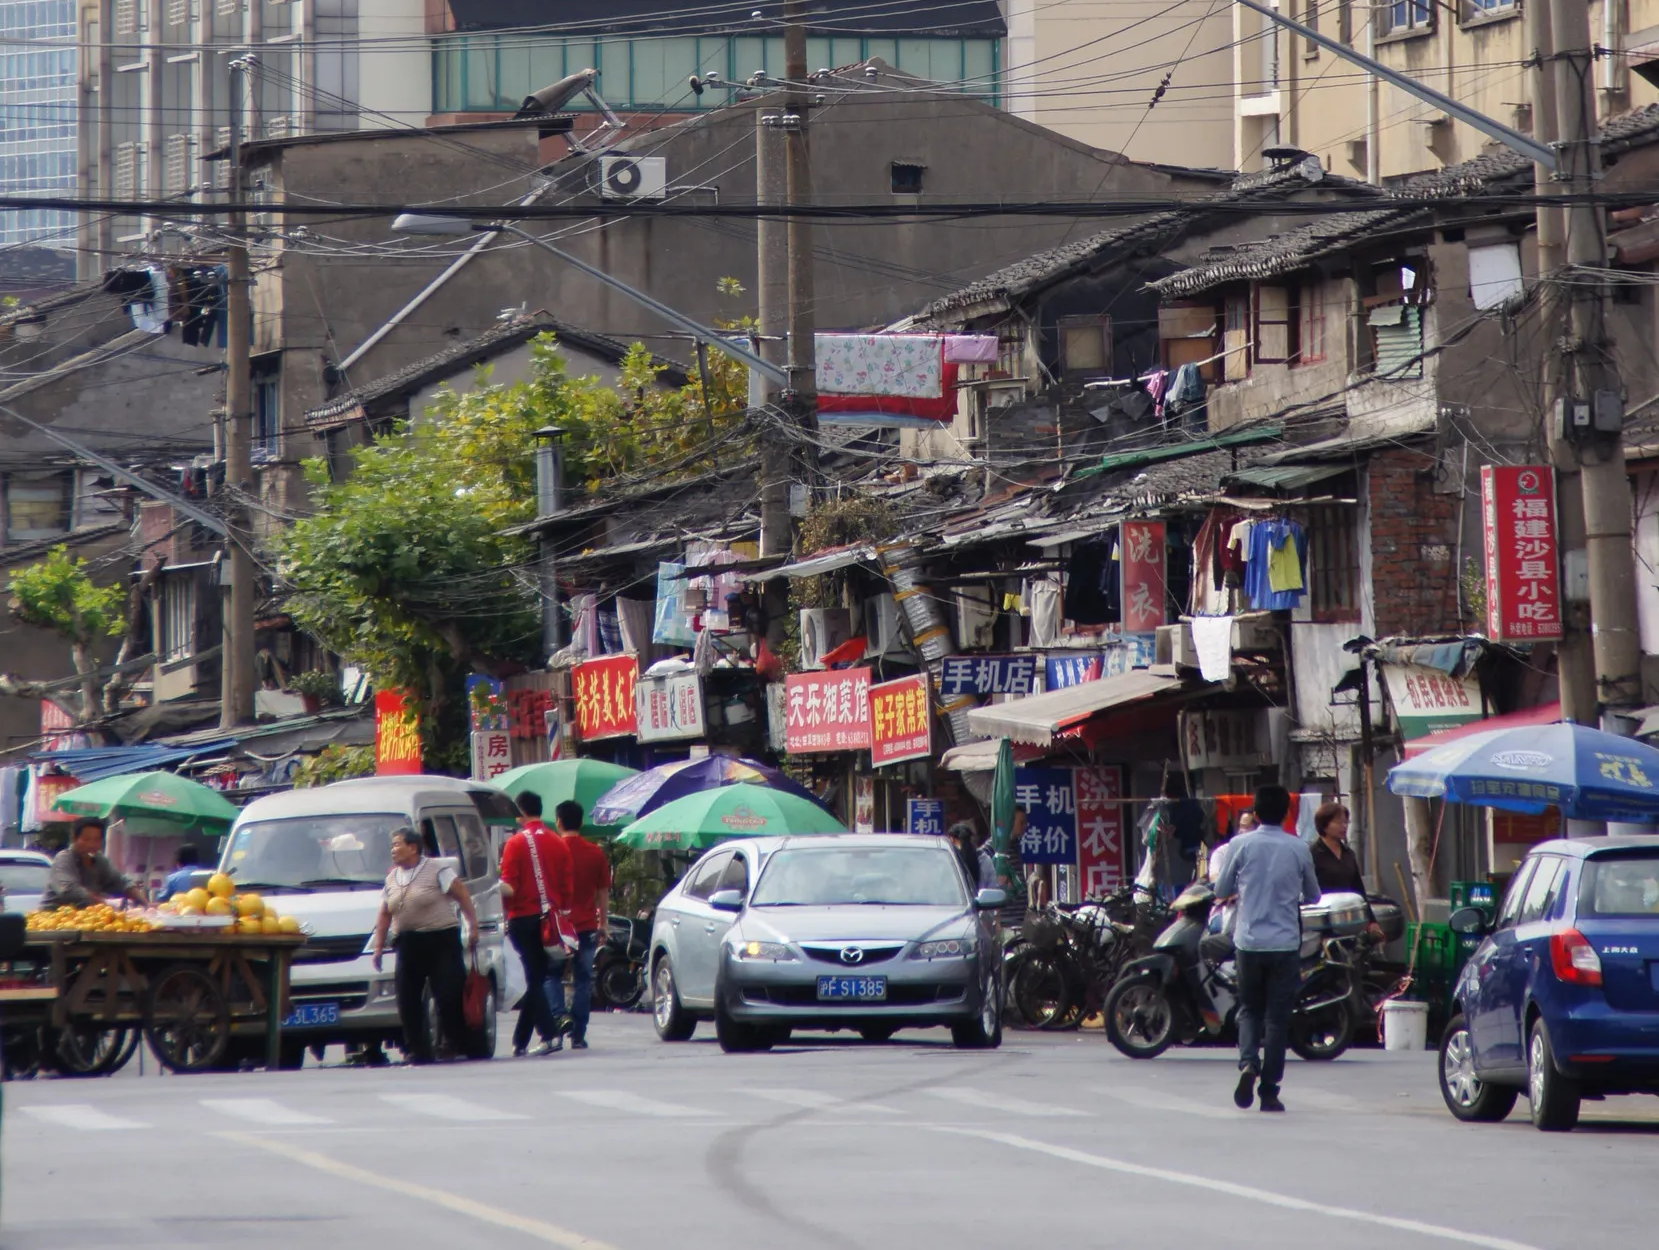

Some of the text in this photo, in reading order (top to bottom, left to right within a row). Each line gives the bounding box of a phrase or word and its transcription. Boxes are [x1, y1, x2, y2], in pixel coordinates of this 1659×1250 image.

[1126, 526, 1160, 622] 洗衣
[1511, 498, 1554, 621] 福建沙县小吃
[789, 676, 868, 728] 天乐湘菜馆
[945, 657, 1032, 694] 手机店
[873, 687, 927, 741] 胖子家常菜
[914, 801, 941, 834] 手机
[1015, 784, 1074, 815] 手机
[1080, 770, 1120, 902] 洗衣店
